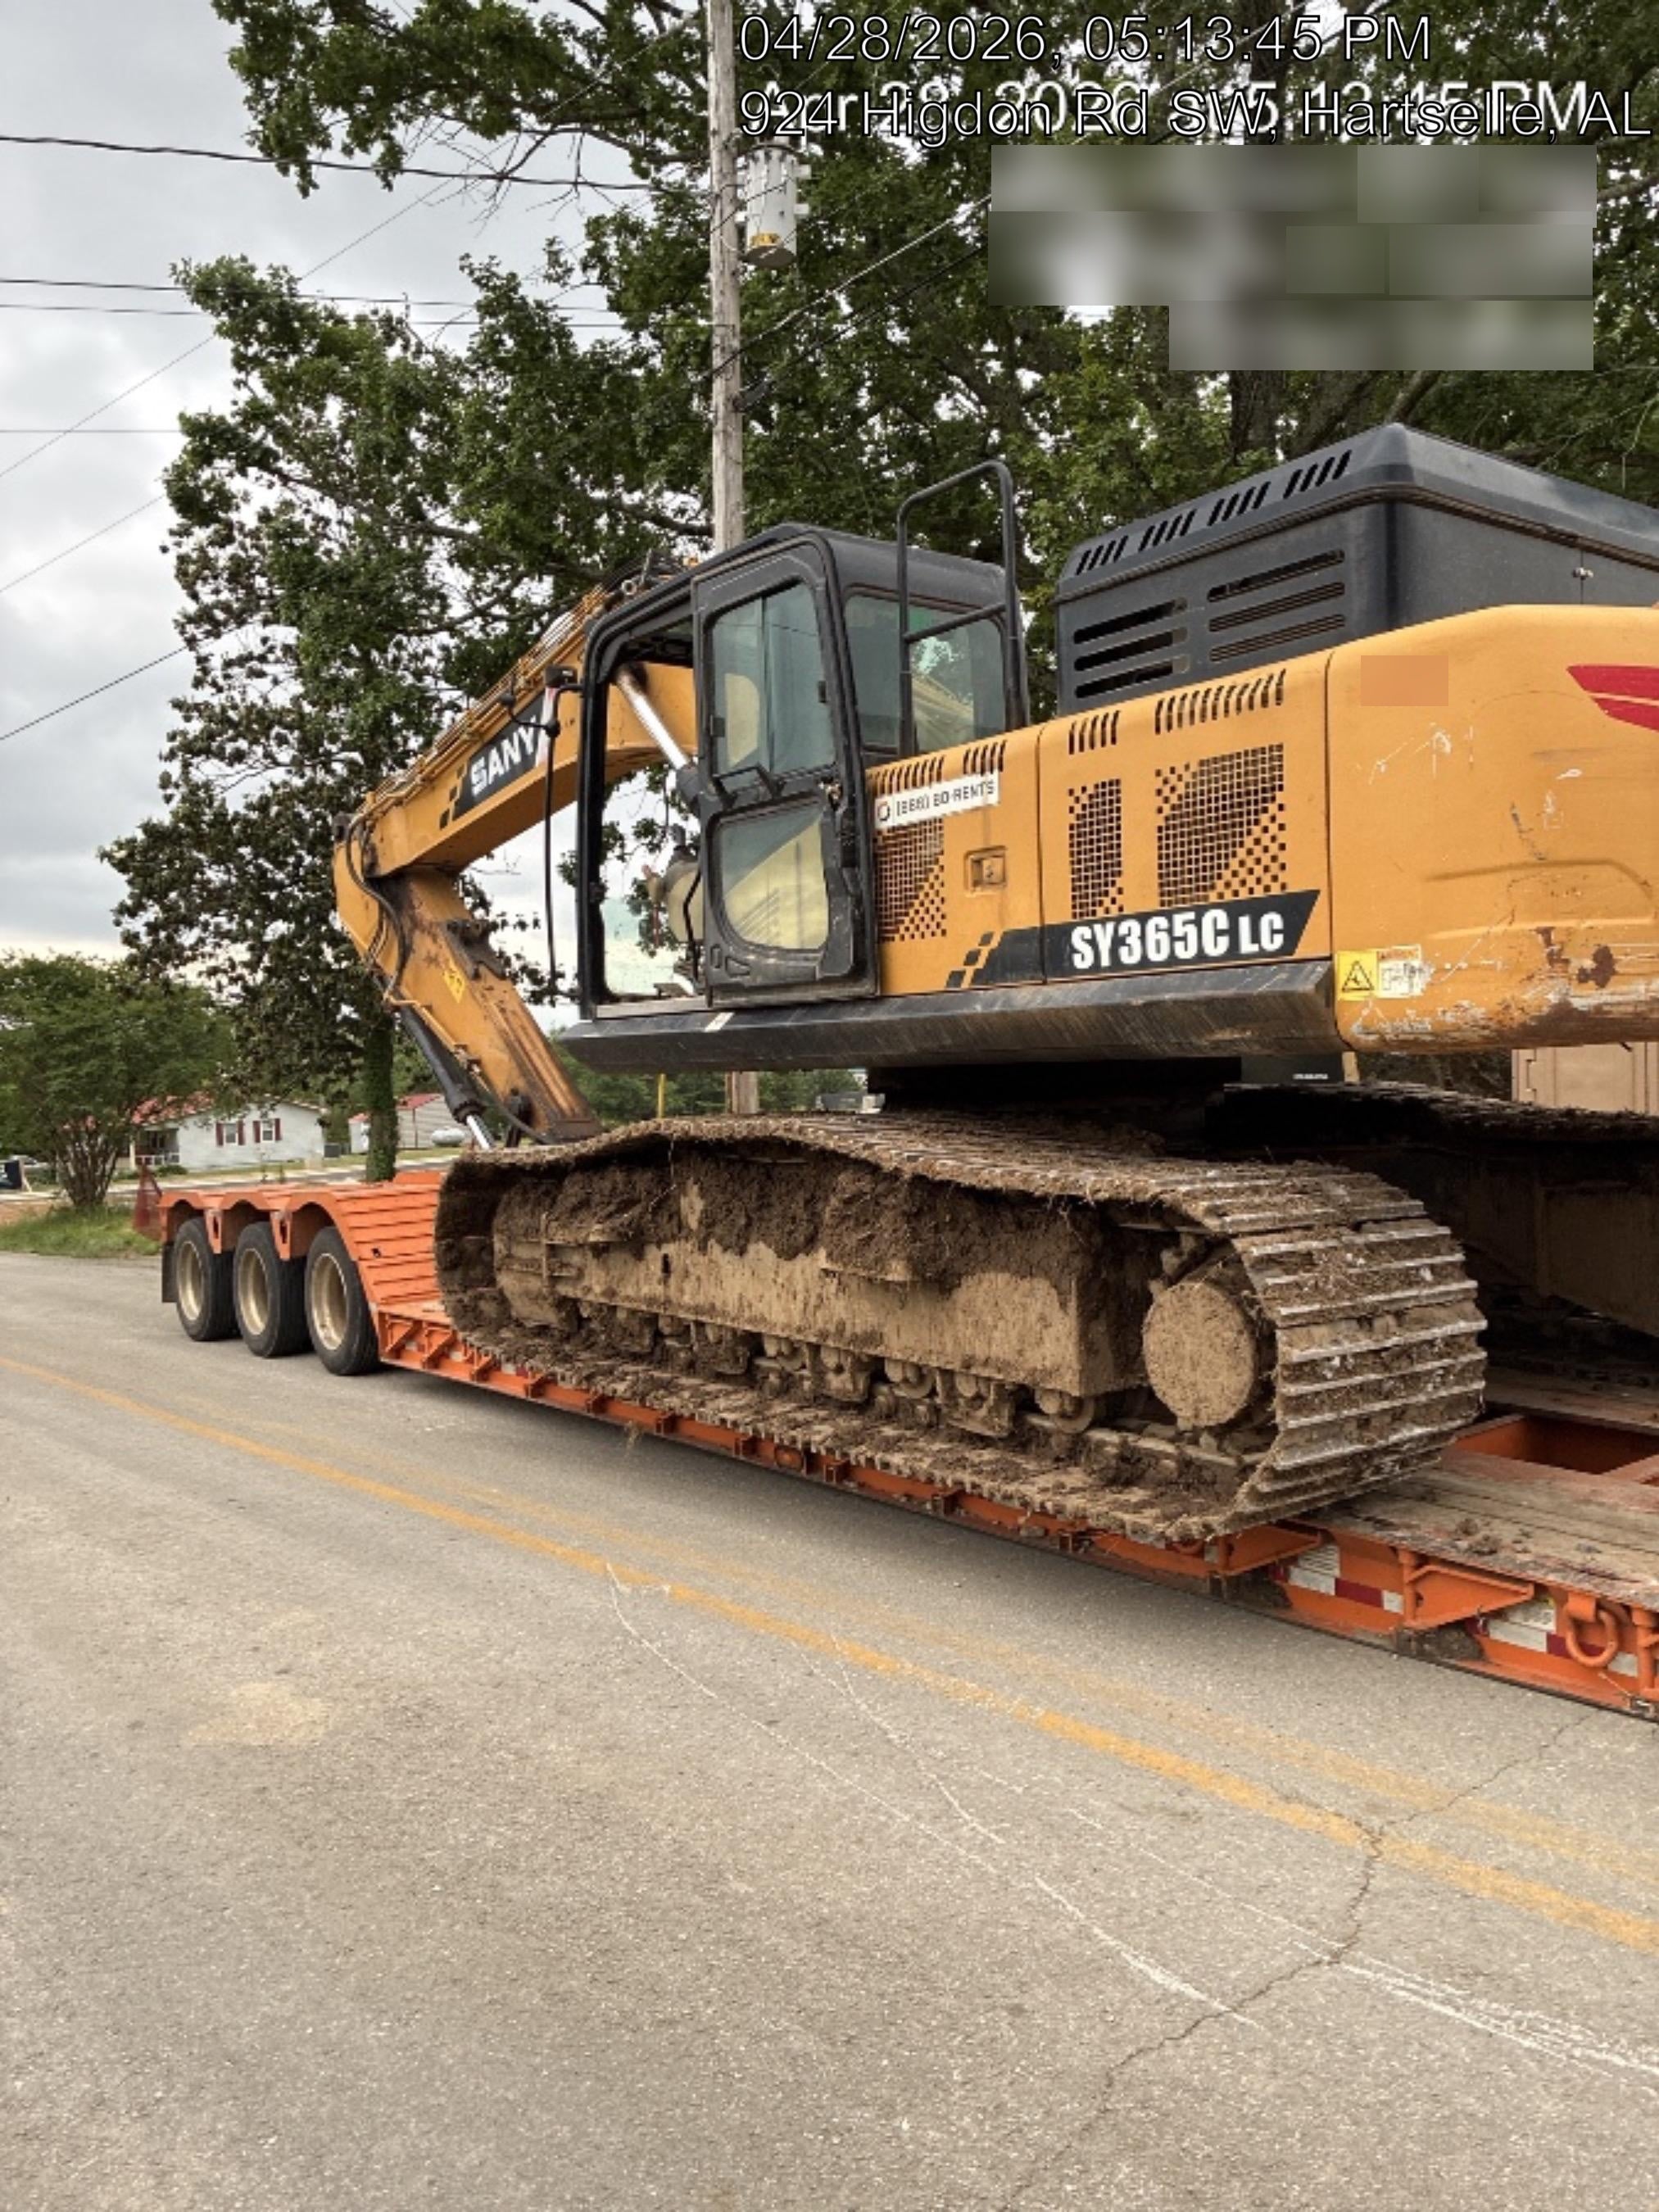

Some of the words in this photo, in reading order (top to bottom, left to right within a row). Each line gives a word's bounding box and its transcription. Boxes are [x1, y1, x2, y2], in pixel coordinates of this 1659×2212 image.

[470, 714, 537, 797] SANY
[1071, 908, 1229, 970] SY365C
[1238, 911, 1285, 954] LC
